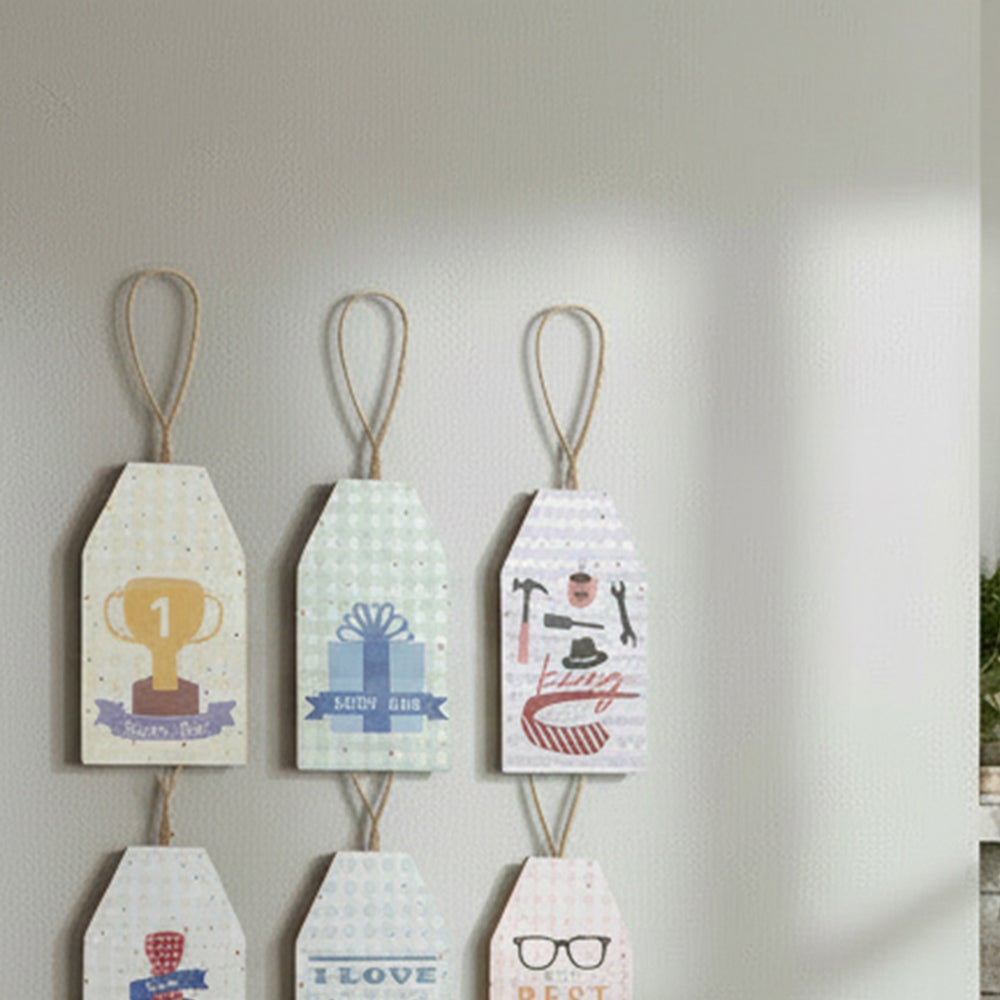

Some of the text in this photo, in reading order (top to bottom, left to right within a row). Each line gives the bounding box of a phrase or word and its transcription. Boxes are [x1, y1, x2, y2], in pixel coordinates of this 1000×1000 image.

[151, 596, 170, 638] 1
[314, 966, 437, 985] I LOVE
